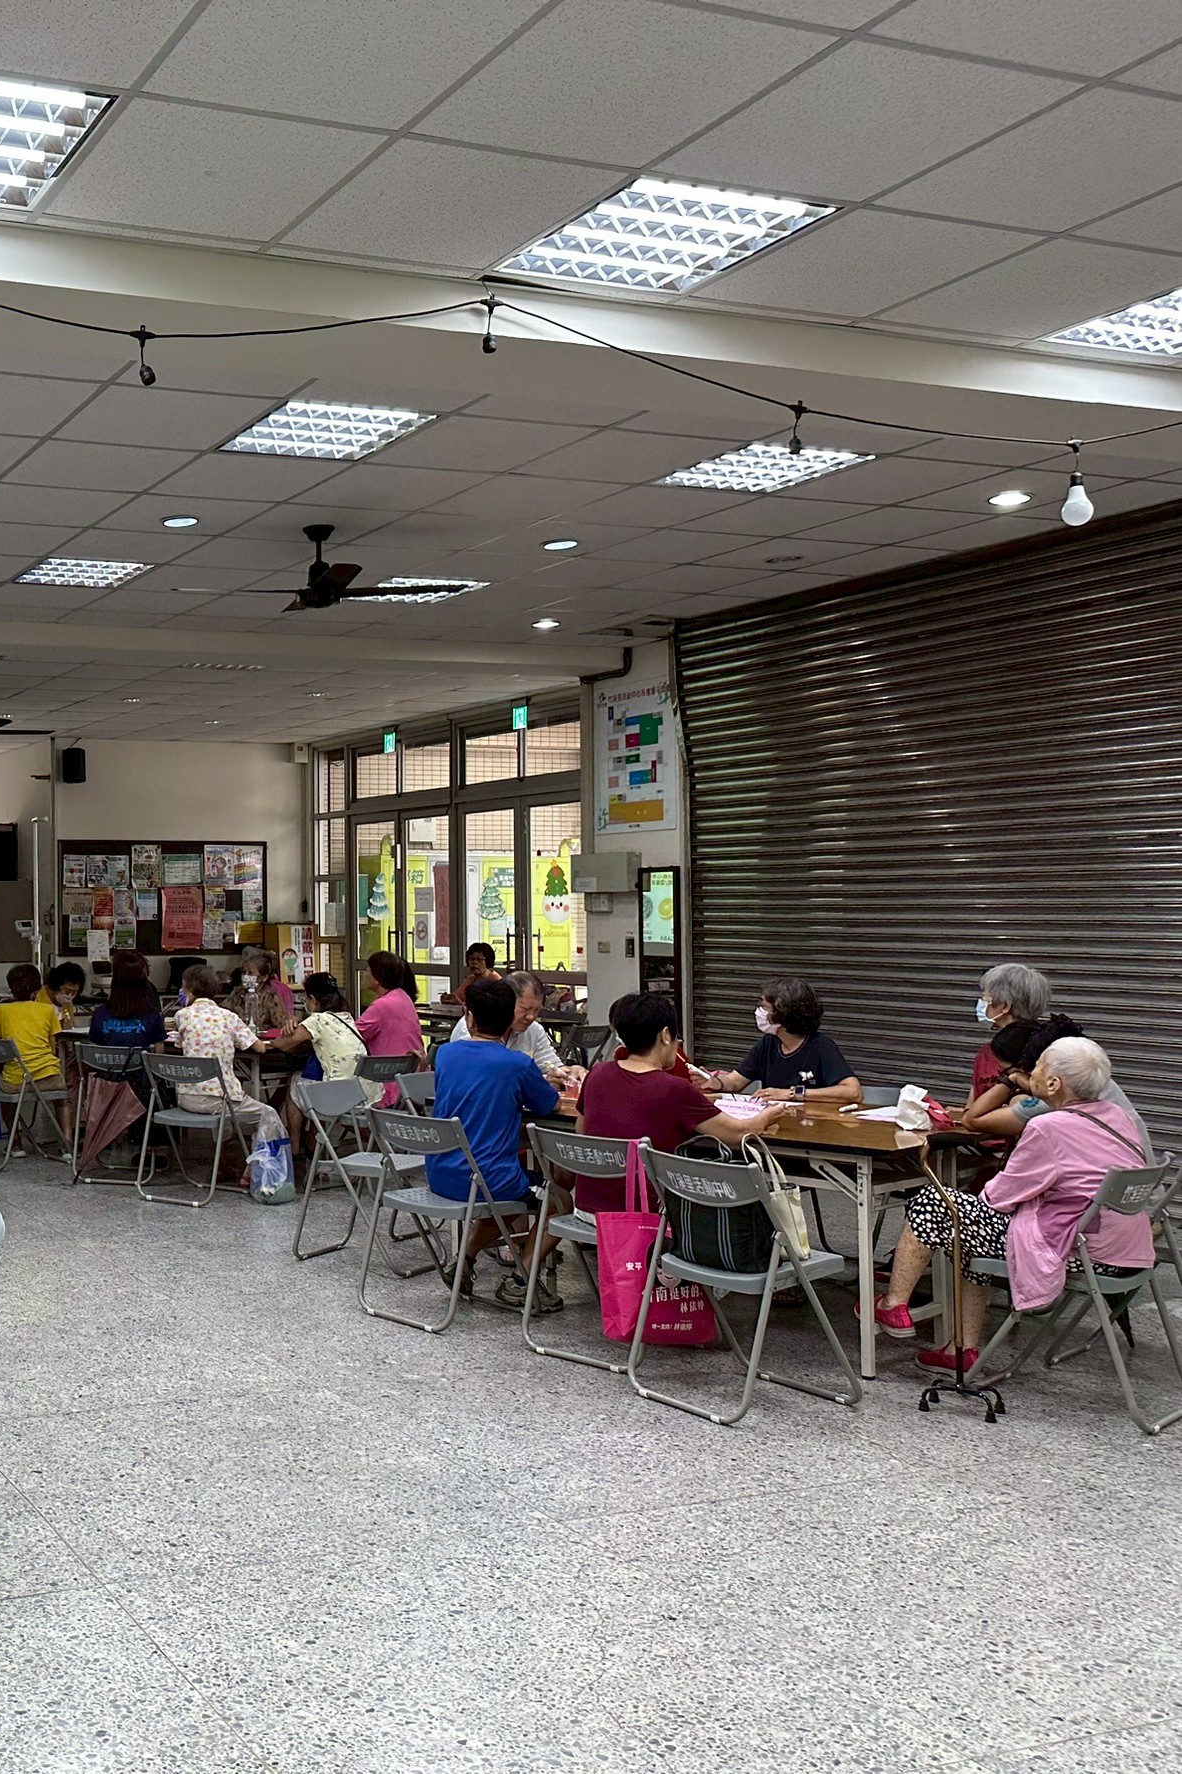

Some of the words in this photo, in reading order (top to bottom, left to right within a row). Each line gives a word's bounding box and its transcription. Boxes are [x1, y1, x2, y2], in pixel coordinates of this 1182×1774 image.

[385, 1121, 440, 1143] 竹溪里活動中心
[556, 1141, 626, 1168] 竹溪里活動中心
[666, 1169, 738, 1199] 竹溪里活動中心
[625, 1261, 643, 1271] 安平
